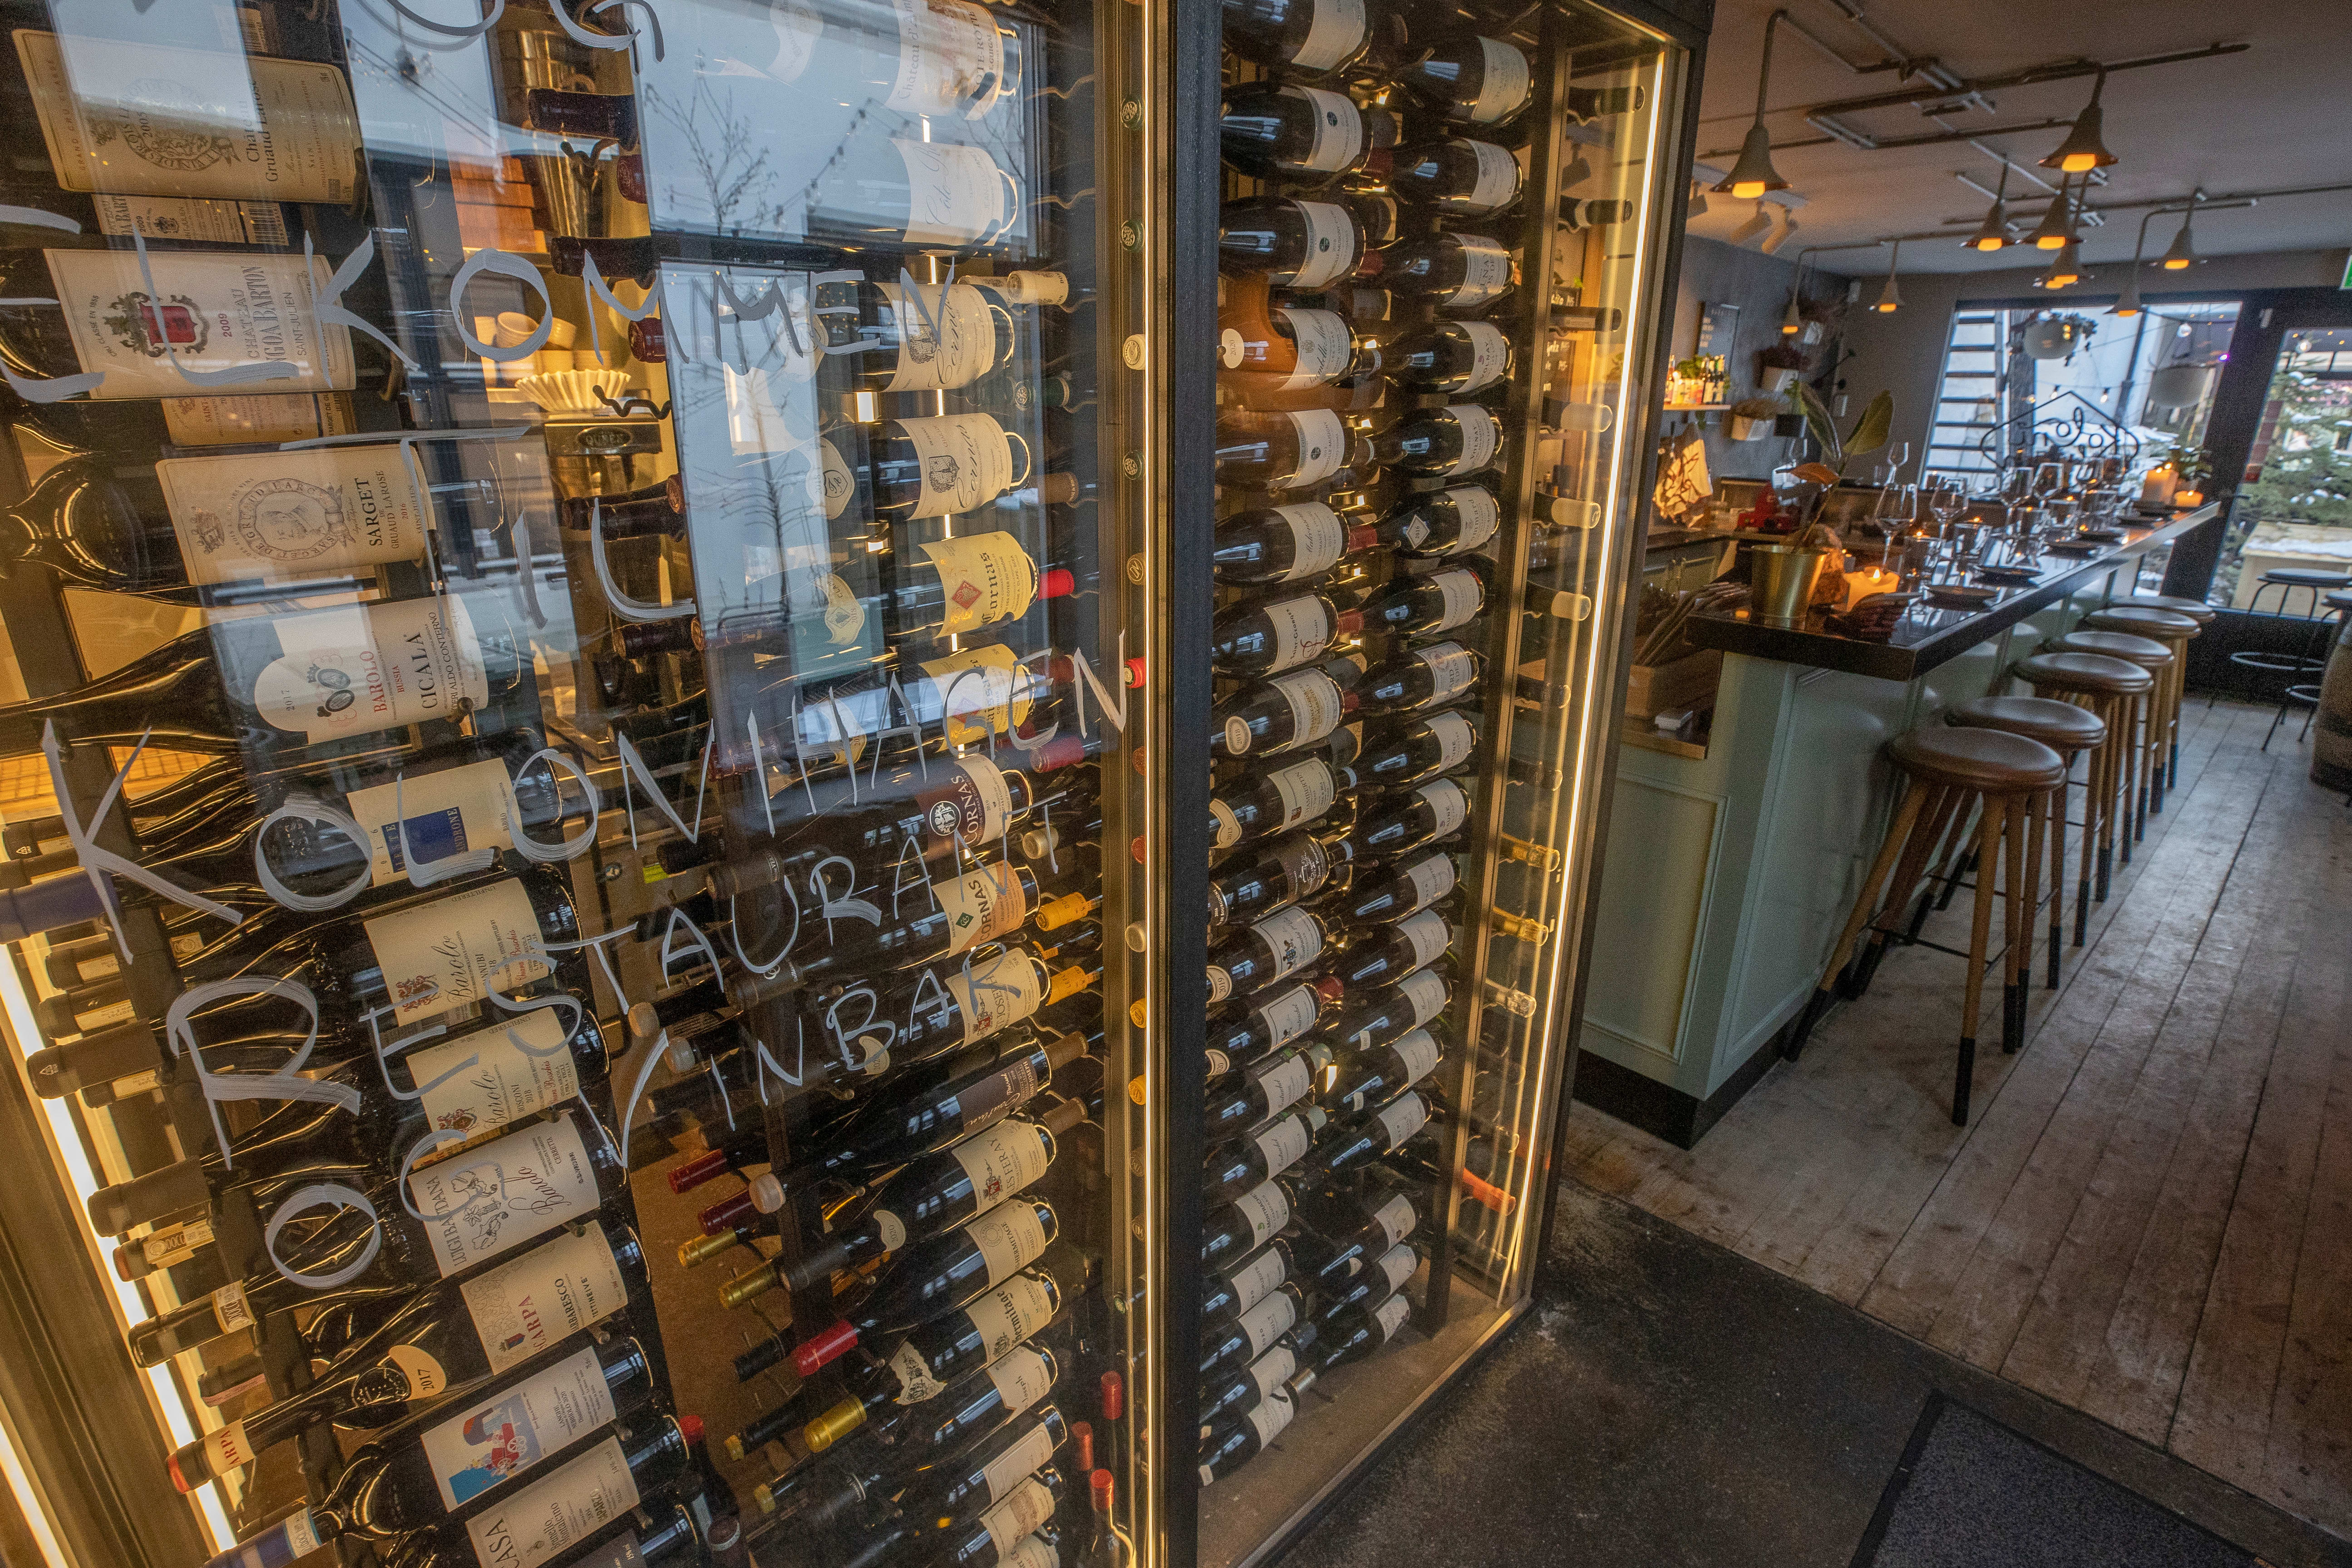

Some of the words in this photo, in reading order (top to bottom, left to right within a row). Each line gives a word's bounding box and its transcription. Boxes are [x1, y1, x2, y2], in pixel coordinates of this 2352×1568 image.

[897, 44, 919, 99] Château
[258, 130, 279, 182] Gruaud
[241, 265, 277, 320] BARTON
[218, 312, 233, 337] 2009
[282, 291, 307, 356] SAINT-JULIEN
[376, 470, 393, 508] LAROSE
[354, 475, 383, 547] SARGET
[400, 503, 408, 519] 2016
[385, 512, 400, 549] GRUAUD
[971, 550, 1003, 623] Cornas
[428, 611, 451, 663] CONTERNO
[359, 650, 388, 712] BAROLO
[391, 665, 405, 692] BUSSIA
[444, 664, 458, 690] ALDO
[281, 688, 295, 711] 2017
[949, 773, 984, 845] CORNAS
[964, 877, 998, 941] CORNAS
[504, 929, 522, 957] Boschis
[428, 934, 474, 1006] Barolo
[537, 1060, 556, 1089] Boschis
[468, 1068, 508, 1129] Barolo
[510, 1083, 526, 1113] MOSCONI
[523, 1089, 534, 1103] 2018
[545, 1136, 562, 1164] CERRETTA
[498, 1164, 572, 1224] Barolo
[446, 1235, 468, 1266] LUIGI
[516, 1294, 549, 1351] SCARPA
[553, 1277, 581, 1332] BARBARESCO
[418, 1368, 435, 1391] 2017
[560, 1390, 569, 1403] 2020
[553, 1405, 565, 1427] LANGHE
[564, 1403, 577, 1429] NEBBIOLO
[541, 1519, 561, 1551] Brunello
[548, 1501, 572, 1544] Montalcino
